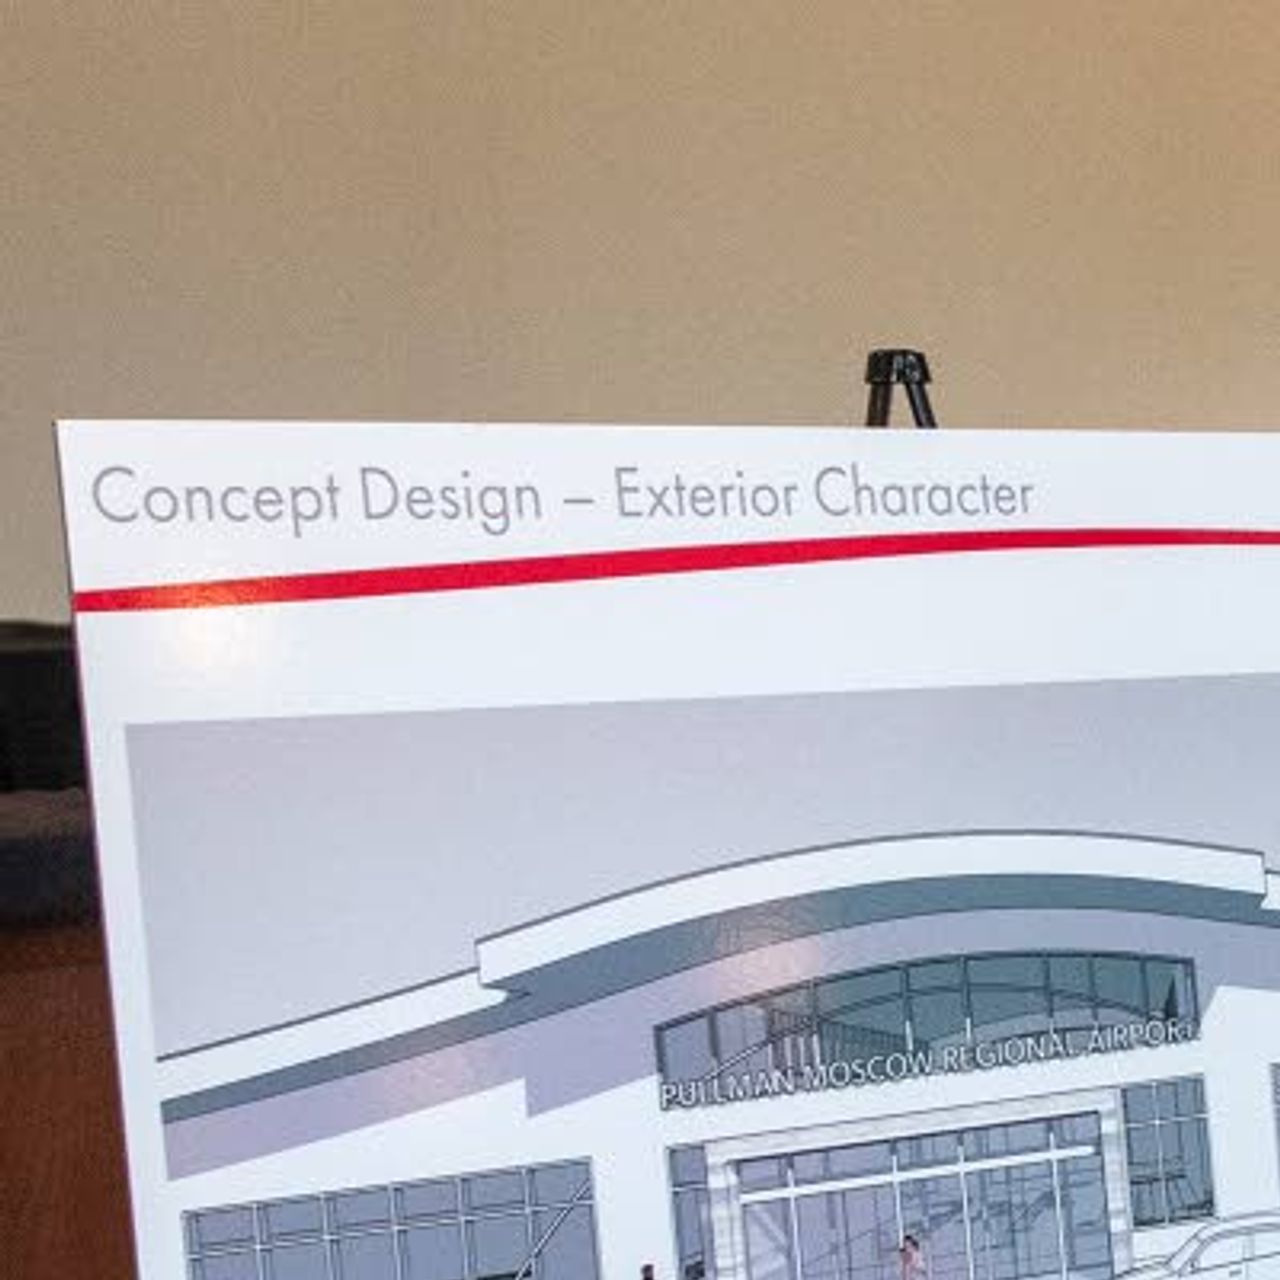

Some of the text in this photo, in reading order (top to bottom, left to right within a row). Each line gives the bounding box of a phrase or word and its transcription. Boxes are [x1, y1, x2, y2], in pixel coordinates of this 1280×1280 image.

[93, 466, 342, 536] Concept
[361, 464, 542, 535] Design
[615, 465, 799, 518] Exterior
[814, 463, 1034, 517] Character
[943, 1031, 1079, 1074] REGIONAL
[1087, 1014, 1196, 1053] AIRPORT
